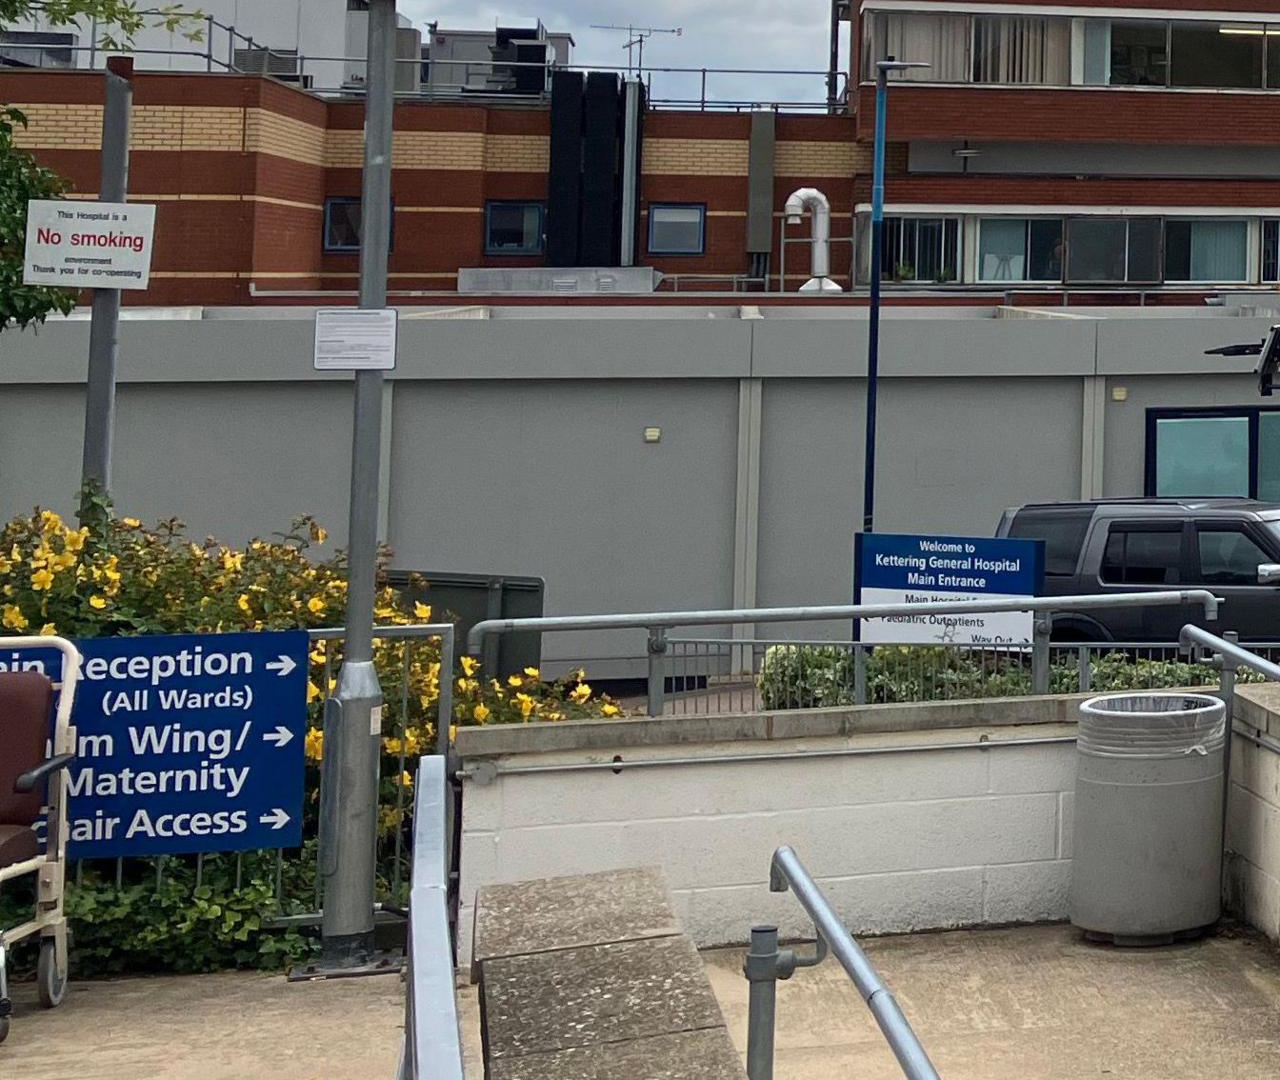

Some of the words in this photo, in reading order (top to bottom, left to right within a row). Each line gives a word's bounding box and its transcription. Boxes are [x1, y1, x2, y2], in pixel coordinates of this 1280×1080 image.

[56, 210, 73, 219] This
[77, 212, 110, 221] Hospital
[112, 213, 119, 221] is
[37, 228, 61, 245] No
[70, 231, 144, 252] smoking
[32, 264, 55, 273] Thank
[60, 267, 74, 275] you
[78, 267, 89, 275] for
[92, 269, 141, 279] co-operating
[920, 540, 963, 553] Welcome
[965, 543, 976, 553] to
[875, 554, 927, 570] Kettering
[929, 556, 971, 570] General
[974, 558, 1020, 574] Hospital
[908, 572, 935, 586] Main
[938, 574, 986, 588] Entrance
[929, 614, 985, 628] Outpatients
[102, 689, 148, 716] (All
[159, 685, 253, 710] Wards)
[129, 721, 252, 760] Wing/
[62, 761, 250, 798] Maternity
[125, 809, 248, 839] Access
